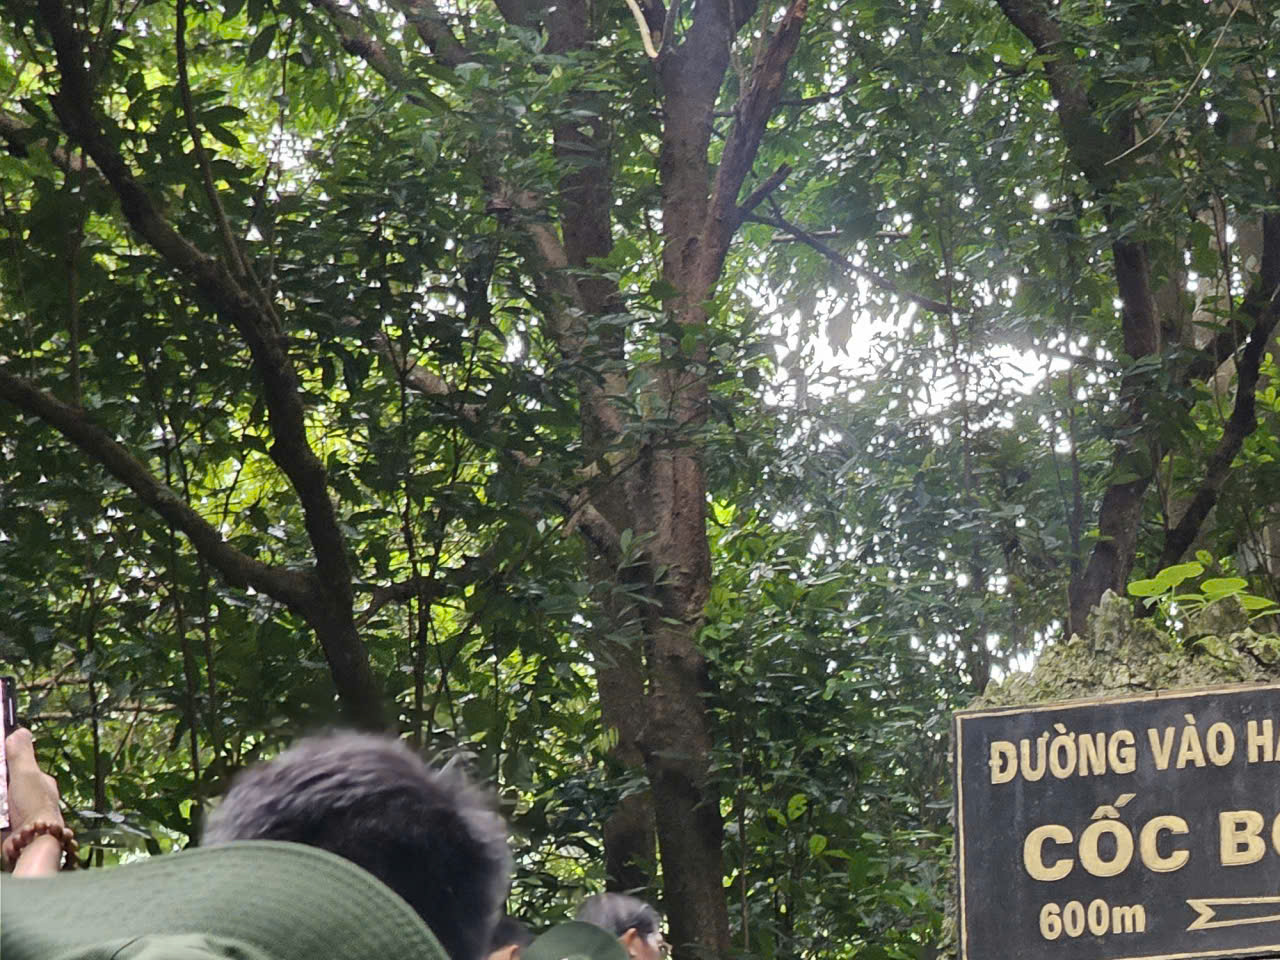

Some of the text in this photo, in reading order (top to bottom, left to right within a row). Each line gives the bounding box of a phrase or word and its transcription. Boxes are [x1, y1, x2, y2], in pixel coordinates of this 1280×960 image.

[989, 723, 1136, 784] ĐƯỜNG
[1148, 714, 1235, 770] VÀO
[1023, 793, 1190, 881] CỐC
[1039, 898, 1146, 940] 600m
